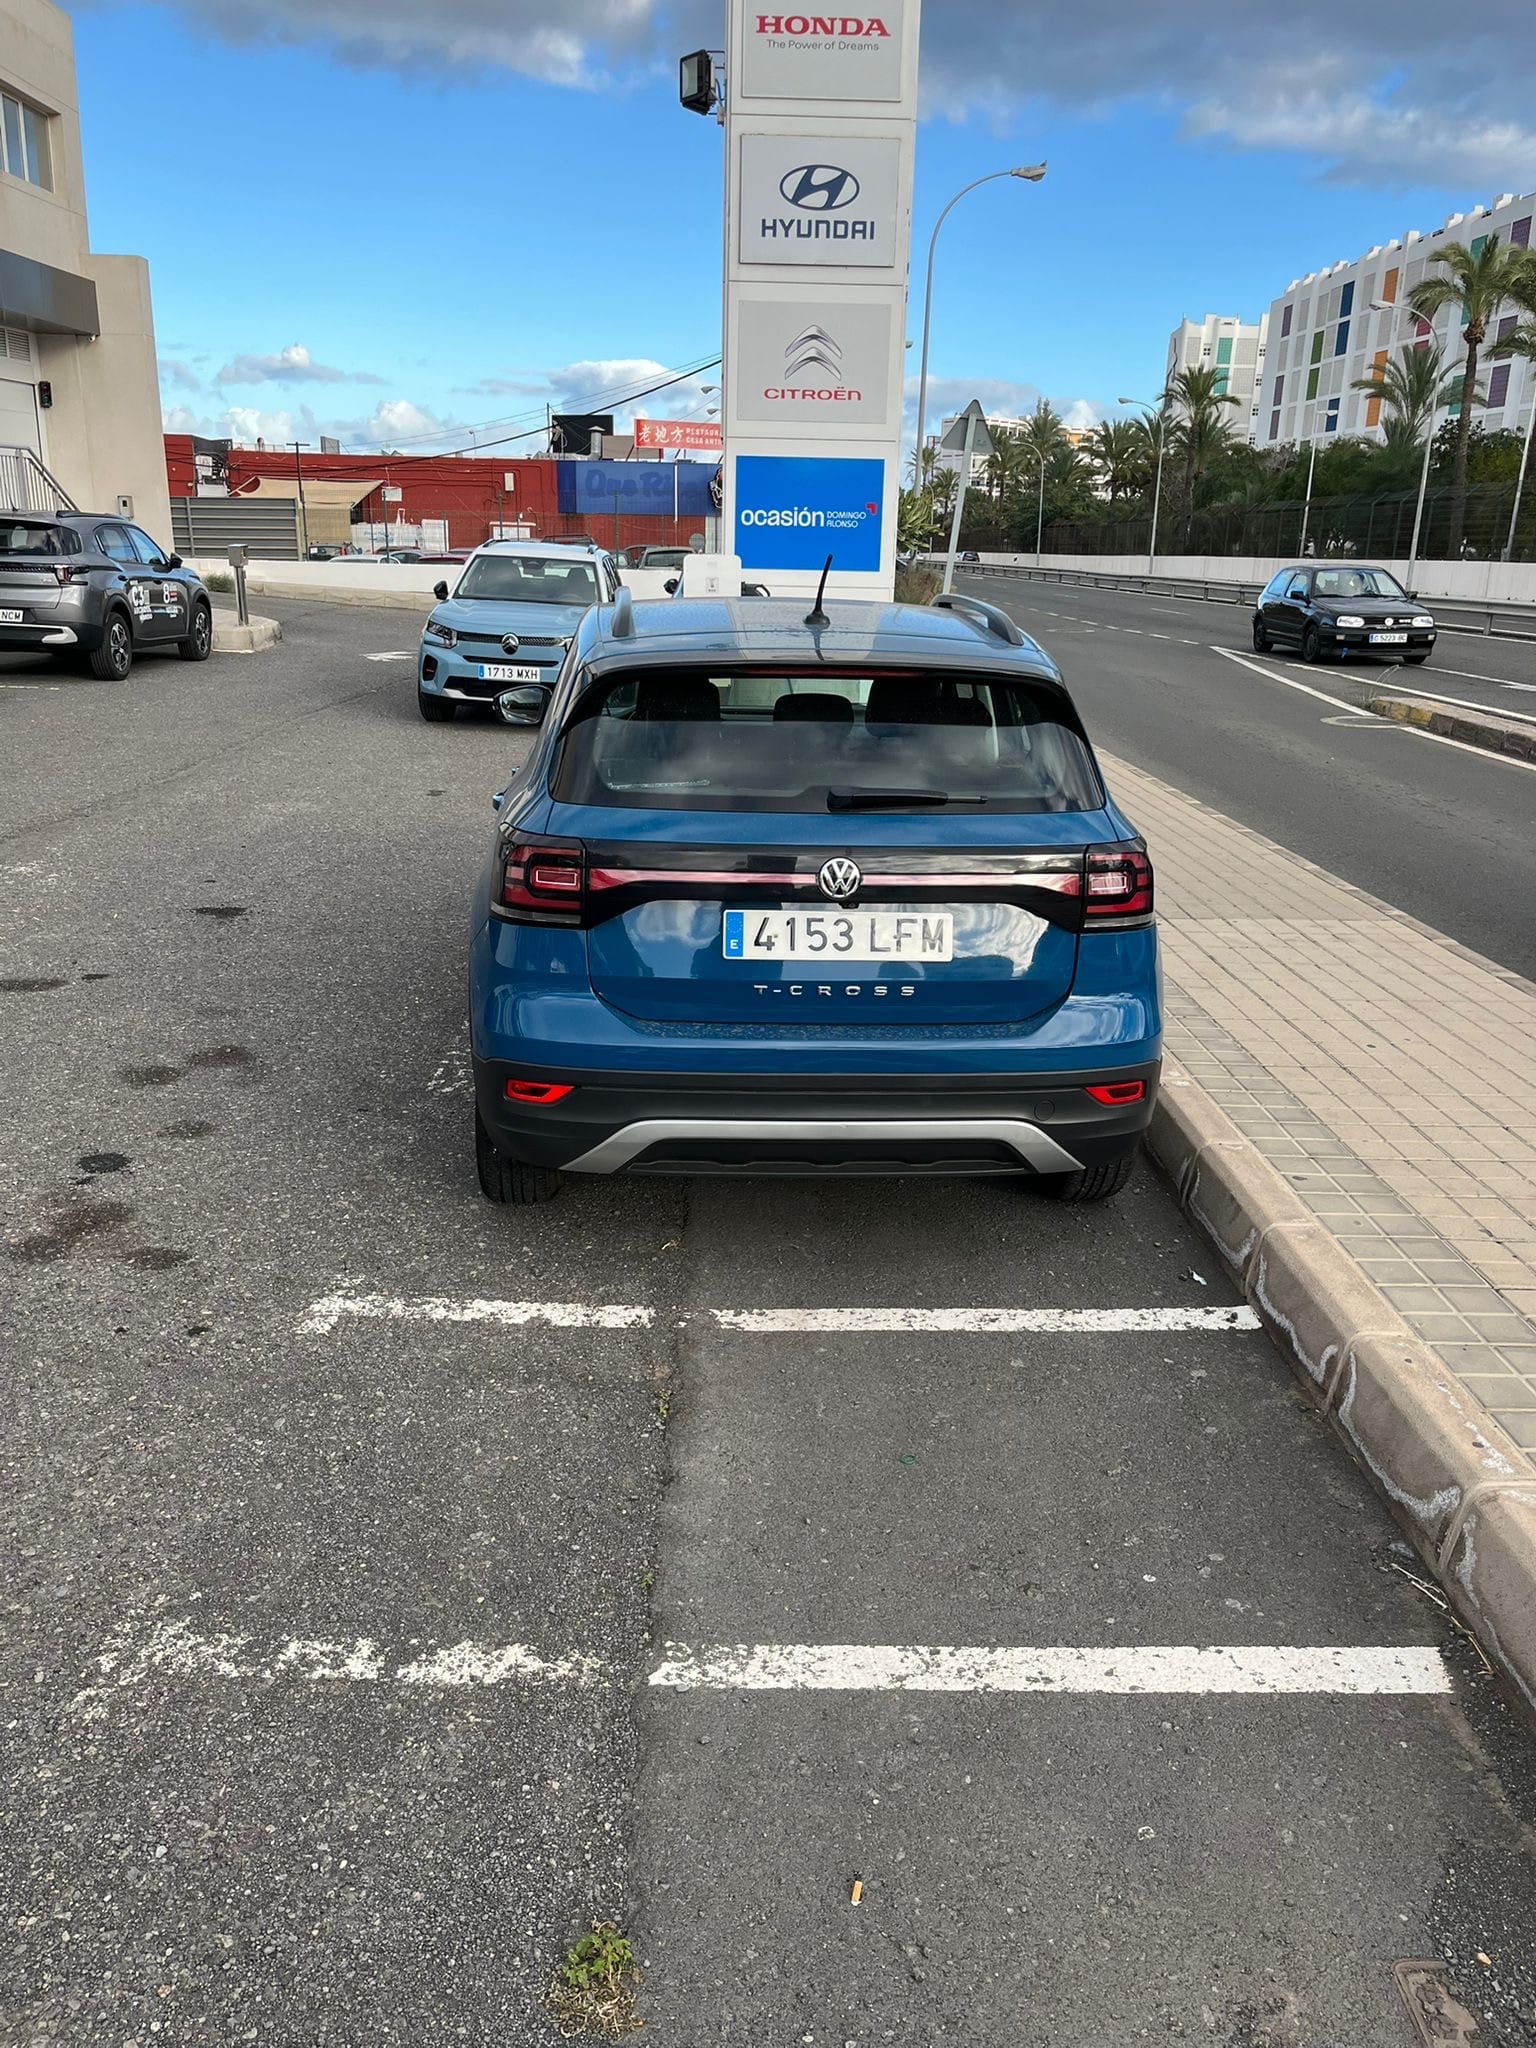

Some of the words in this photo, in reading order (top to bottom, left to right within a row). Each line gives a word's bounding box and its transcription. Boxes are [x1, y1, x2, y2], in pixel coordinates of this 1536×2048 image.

[756, 15, 891, 37] HONDA
[766, 39, 786, 50] The
[788, 40, 823, 51] Power
[824, 40, 836, 51] of
[838, 40, 880, 52] Dreams
[761, 218, 875, 240] HYUNDAI
[638, 424, 685, 444] 老地方
[685, 428, 722, 437] RESTAUR
[704, 438, 721, 446] ANTI
[740, 506, 825, 528] ocasión
[826, 511, 867, 520] DOMINGO
[826, 520, 858, 528] ALONSO
[163, 583, 170, 604] 8
[1, 611, 21, 620] NCM
[488, 667, 514, 678] 1713
[517, 668, 538, 679] MXH
[754, 917, 854, 952] 4153
[870, 918, 944, 953] LFM
[730, 939, 738, 950] E
[754, 984, 915, 997] T-CROSS
